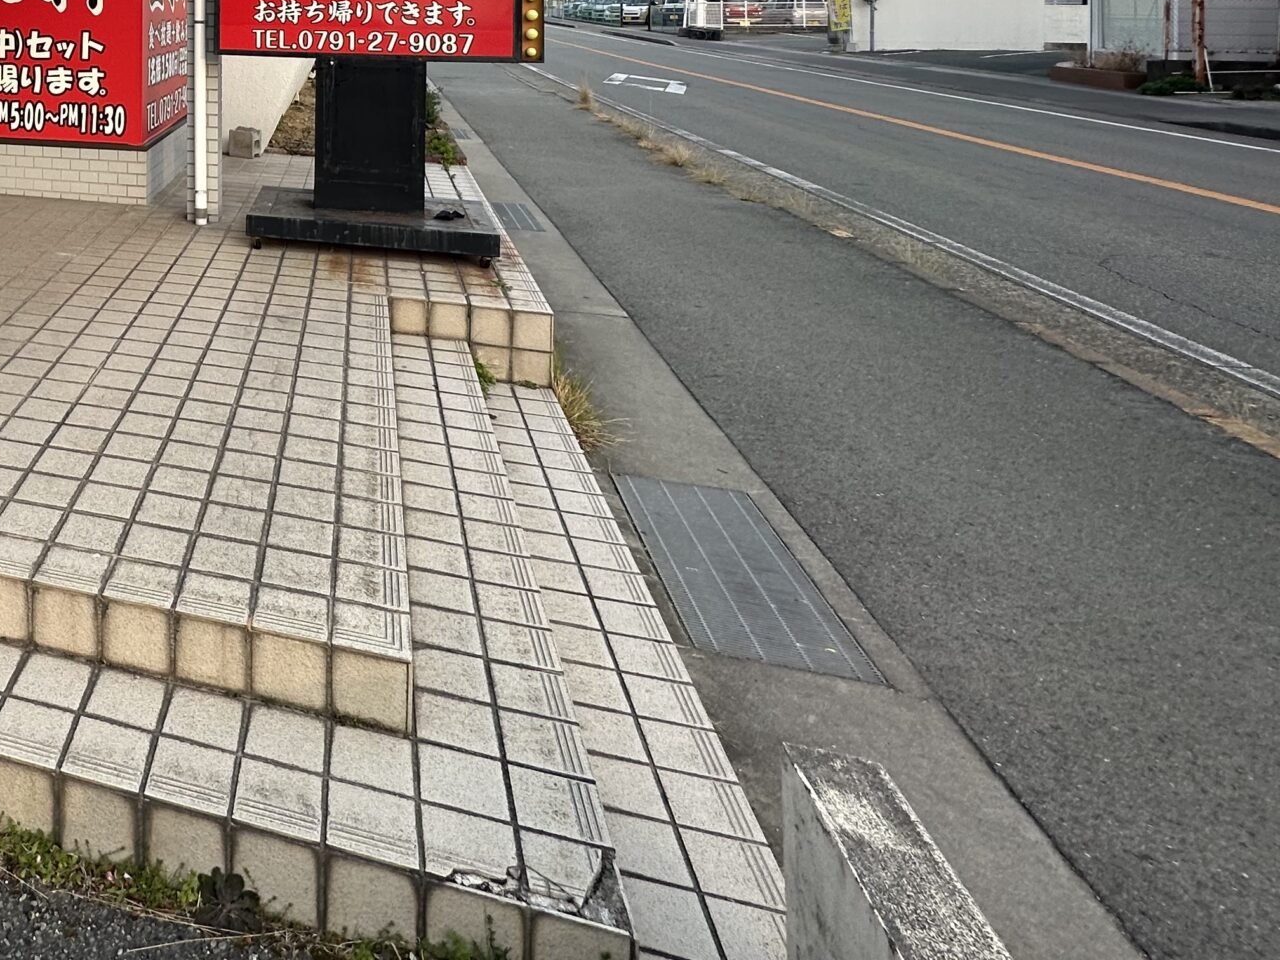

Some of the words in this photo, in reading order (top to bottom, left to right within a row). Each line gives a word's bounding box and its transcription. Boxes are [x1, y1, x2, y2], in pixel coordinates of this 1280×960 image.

[253, 0, 475, 27] お持ち帰りできます。
[252, 29, 474, 55] TEL.0791-27-9087
